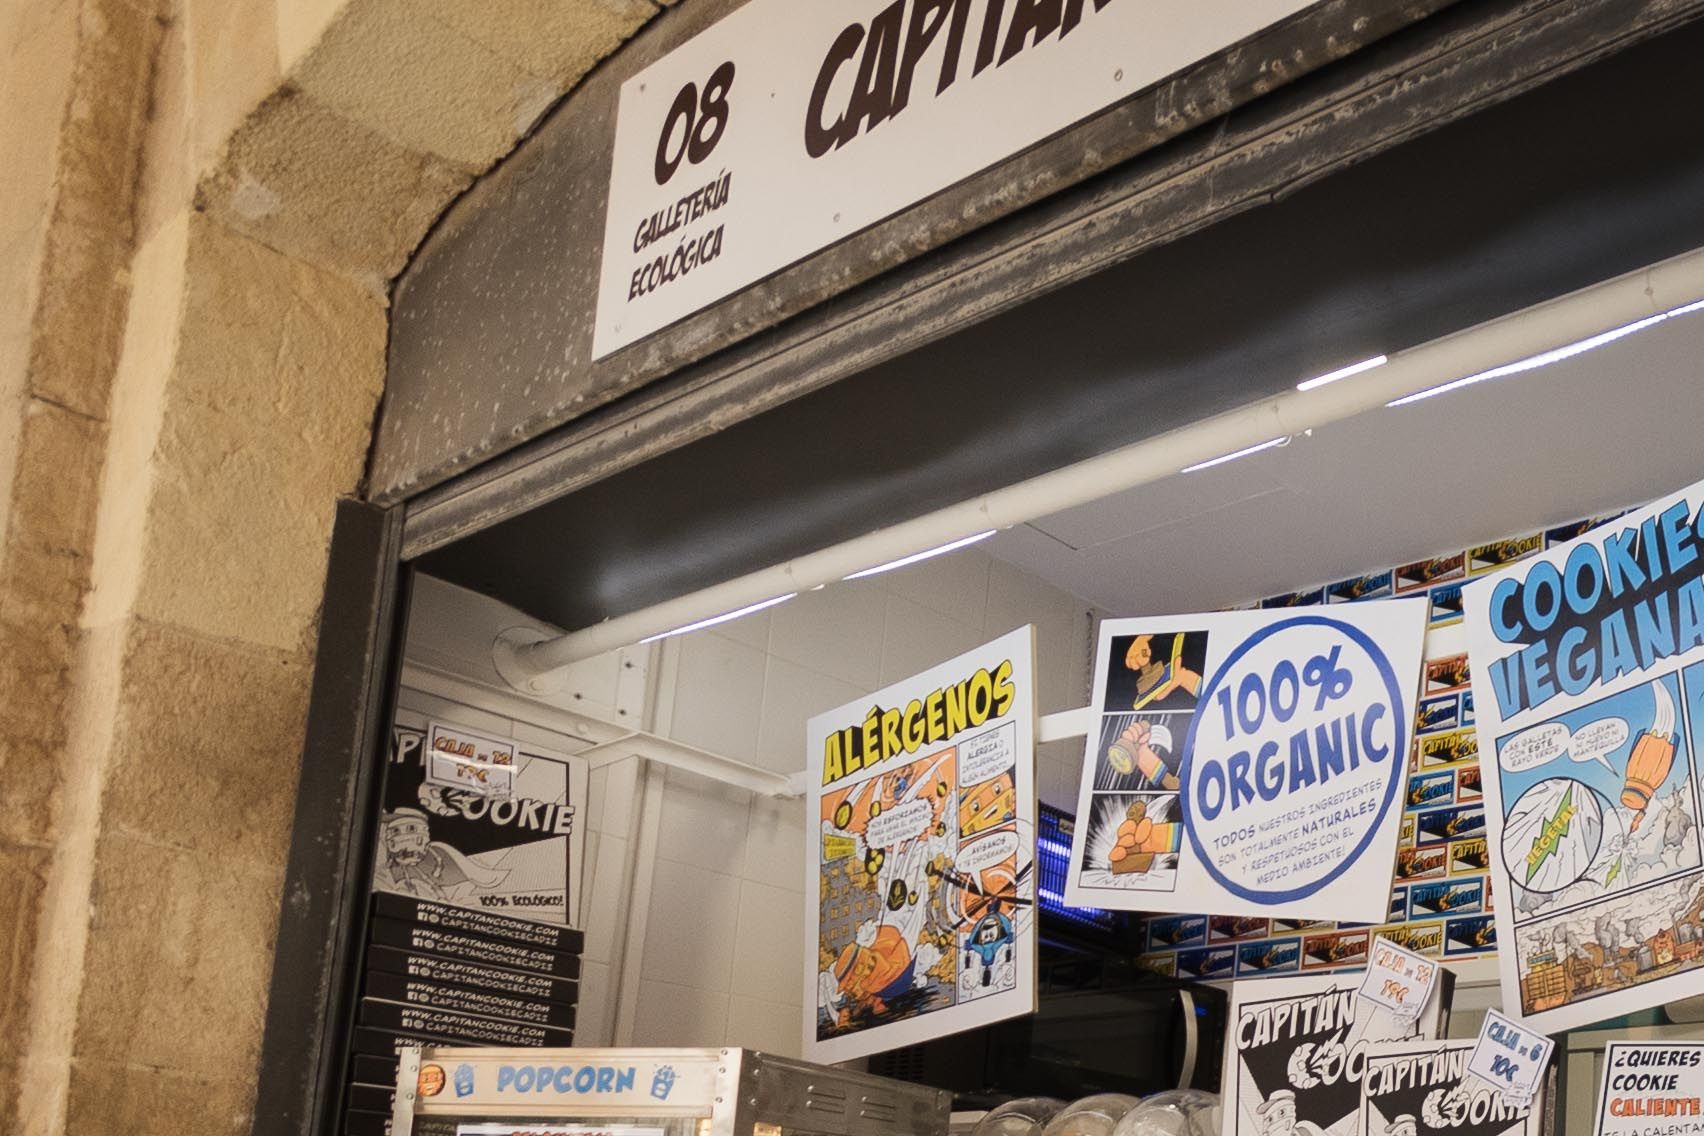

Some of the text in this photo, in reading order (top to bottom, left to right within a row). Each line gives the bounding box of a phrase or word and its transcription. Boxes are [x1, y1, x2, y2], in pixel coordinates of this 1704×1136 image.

[655, 61, 735, 185] 08
[633, 168, 732, 253] GALLETERÍA
[628, 223, 724, 302] ECOLÓGICA
[821, 658, 1017, 786] ALÉRGENOS
[1217, 644, 1353, 742] 100%
[1197, 702, 1390, 822] ORGANIC
[1214, 778, 1383, 851] TODOS INGREDIENTES
[1239, 797, 1377, 859] TOTALMENTE NATURALES
[1256, 845, 1347, 886] MEDIO AMBIENTE!
[1236, 983, 1357, 1051] CAPITÁN
[1382, 979, 1410, 1004] 19€
[497, 1066, 636, 1093] POPCORN
[1363, 1043, 1468, 1097] CAPITÁN
[1490, 1054, 1519, 1082] 10€
[1612, 1073, 1679, 1091] COOKIE
[1614, 1050, 1701, 1068] ¿QUIERES
